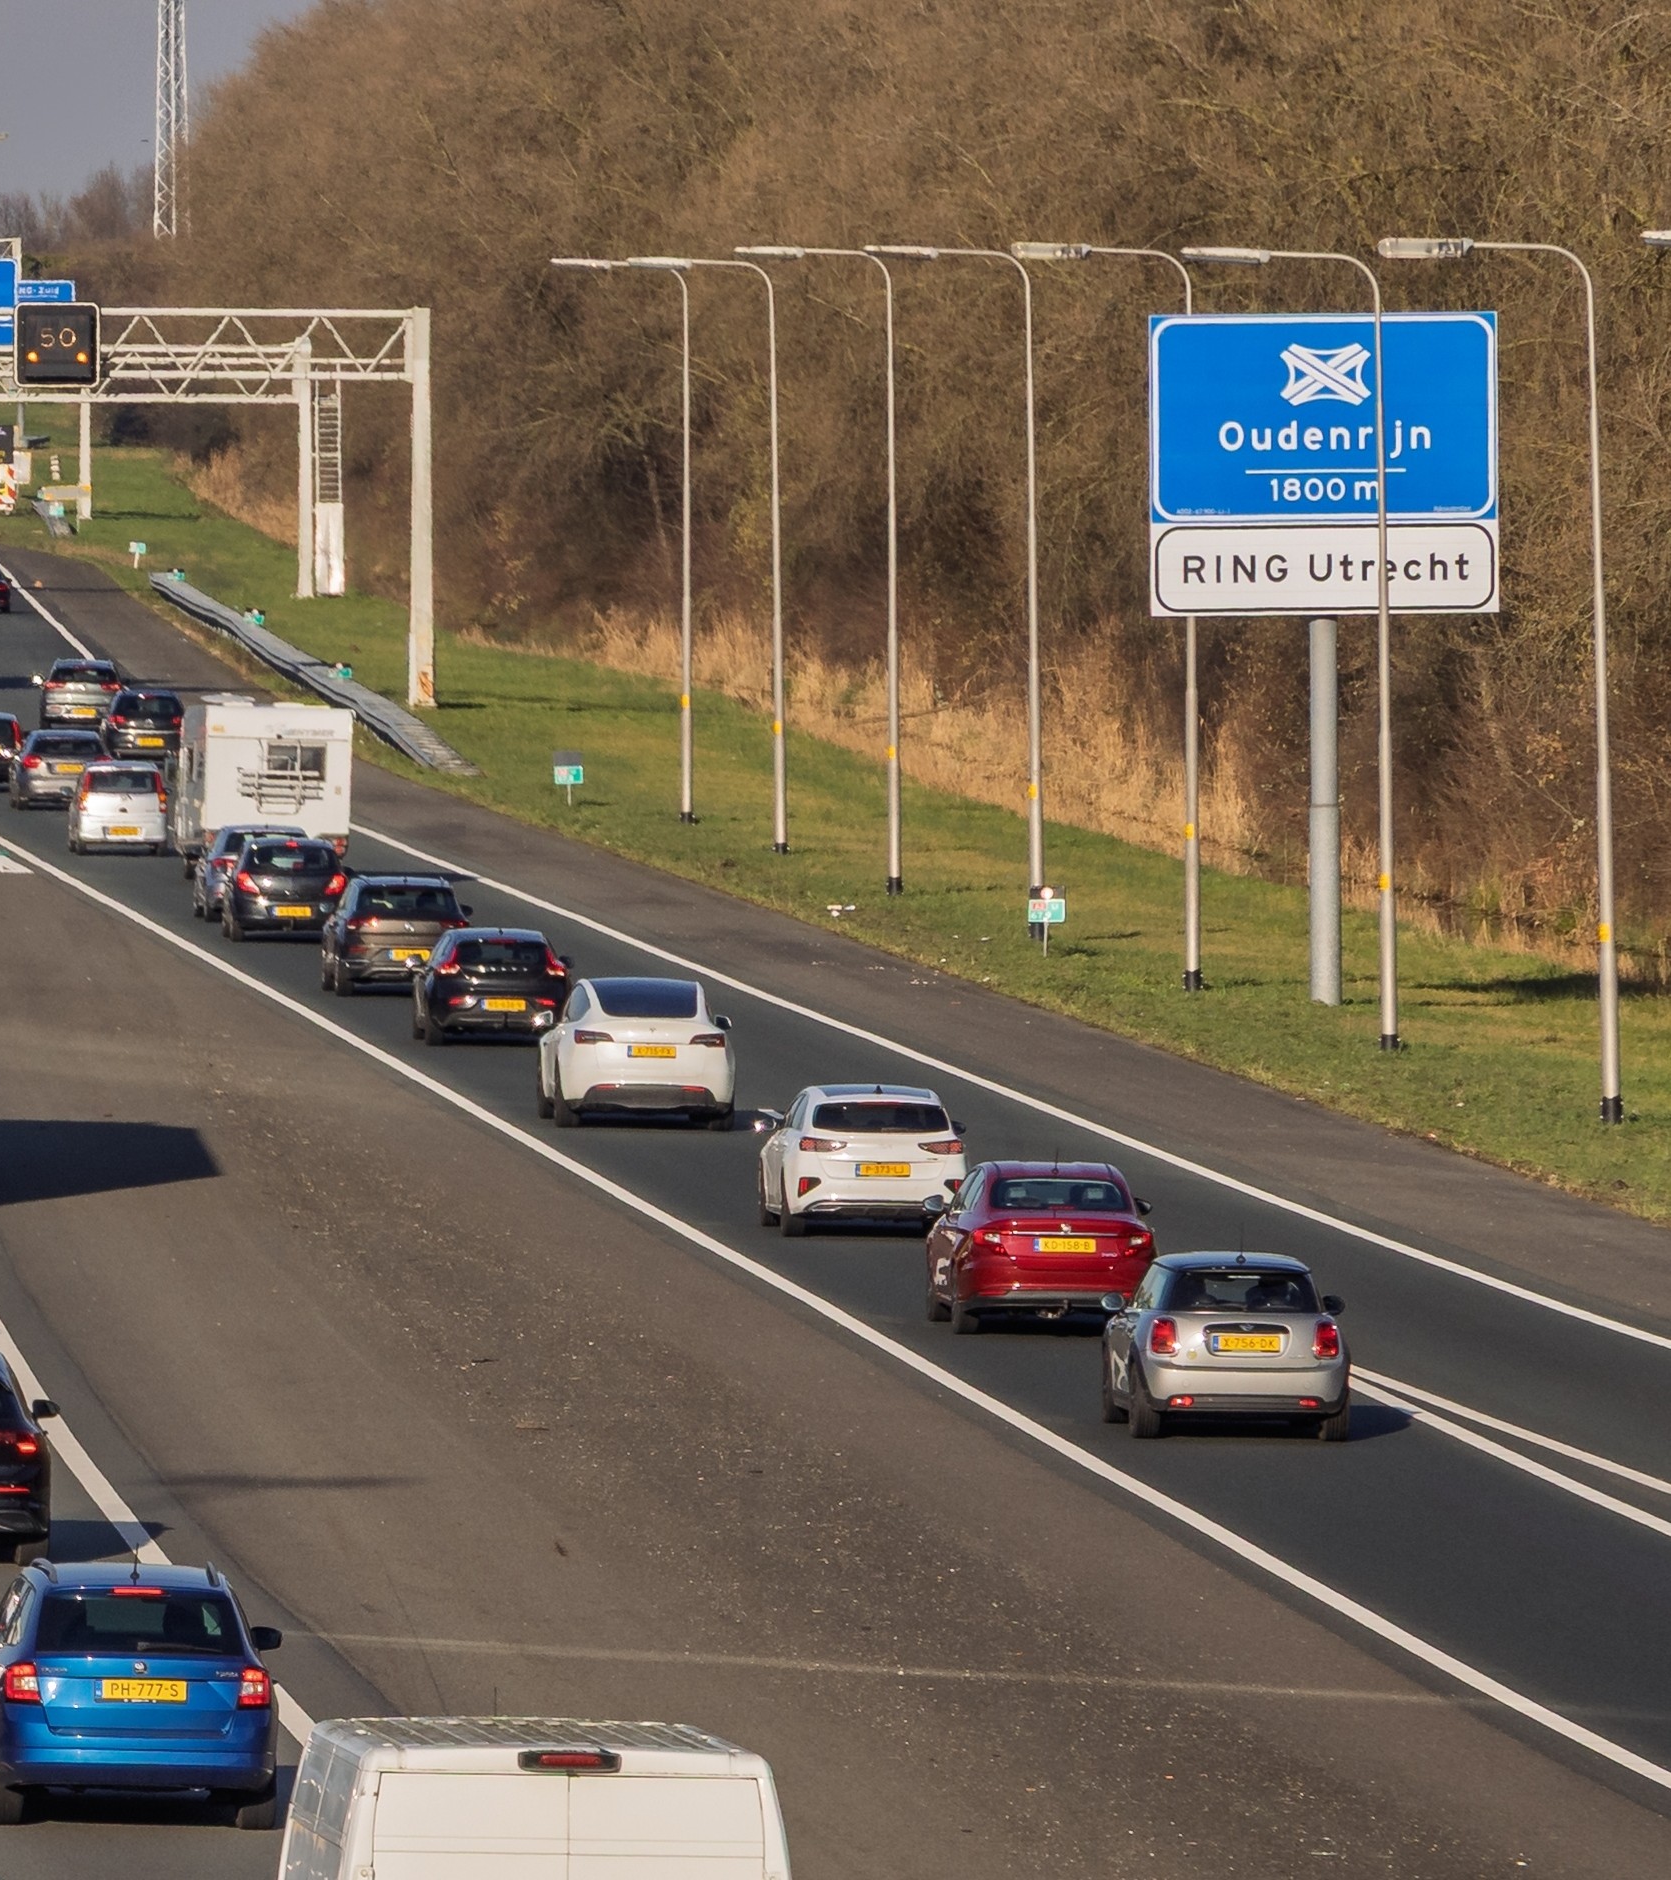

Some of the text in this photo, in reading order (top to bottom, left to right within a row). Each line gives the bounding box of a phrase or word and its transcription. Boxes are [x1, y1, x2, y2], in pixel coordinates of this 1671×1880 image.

[40, 327, 77, 348] 50
[1218, 420, 1432, 459] Oudenrjn
[1270, 478, 1379, 502] 1800 m
[1182, 552, 1470, 584] RING Utrecht
[1043, 1241, 1091, 1251] KD-158-B
[1223, 1337, 1276, 1348] X-756-DK
[109, 1683, 179, 1697] PH-777-S
